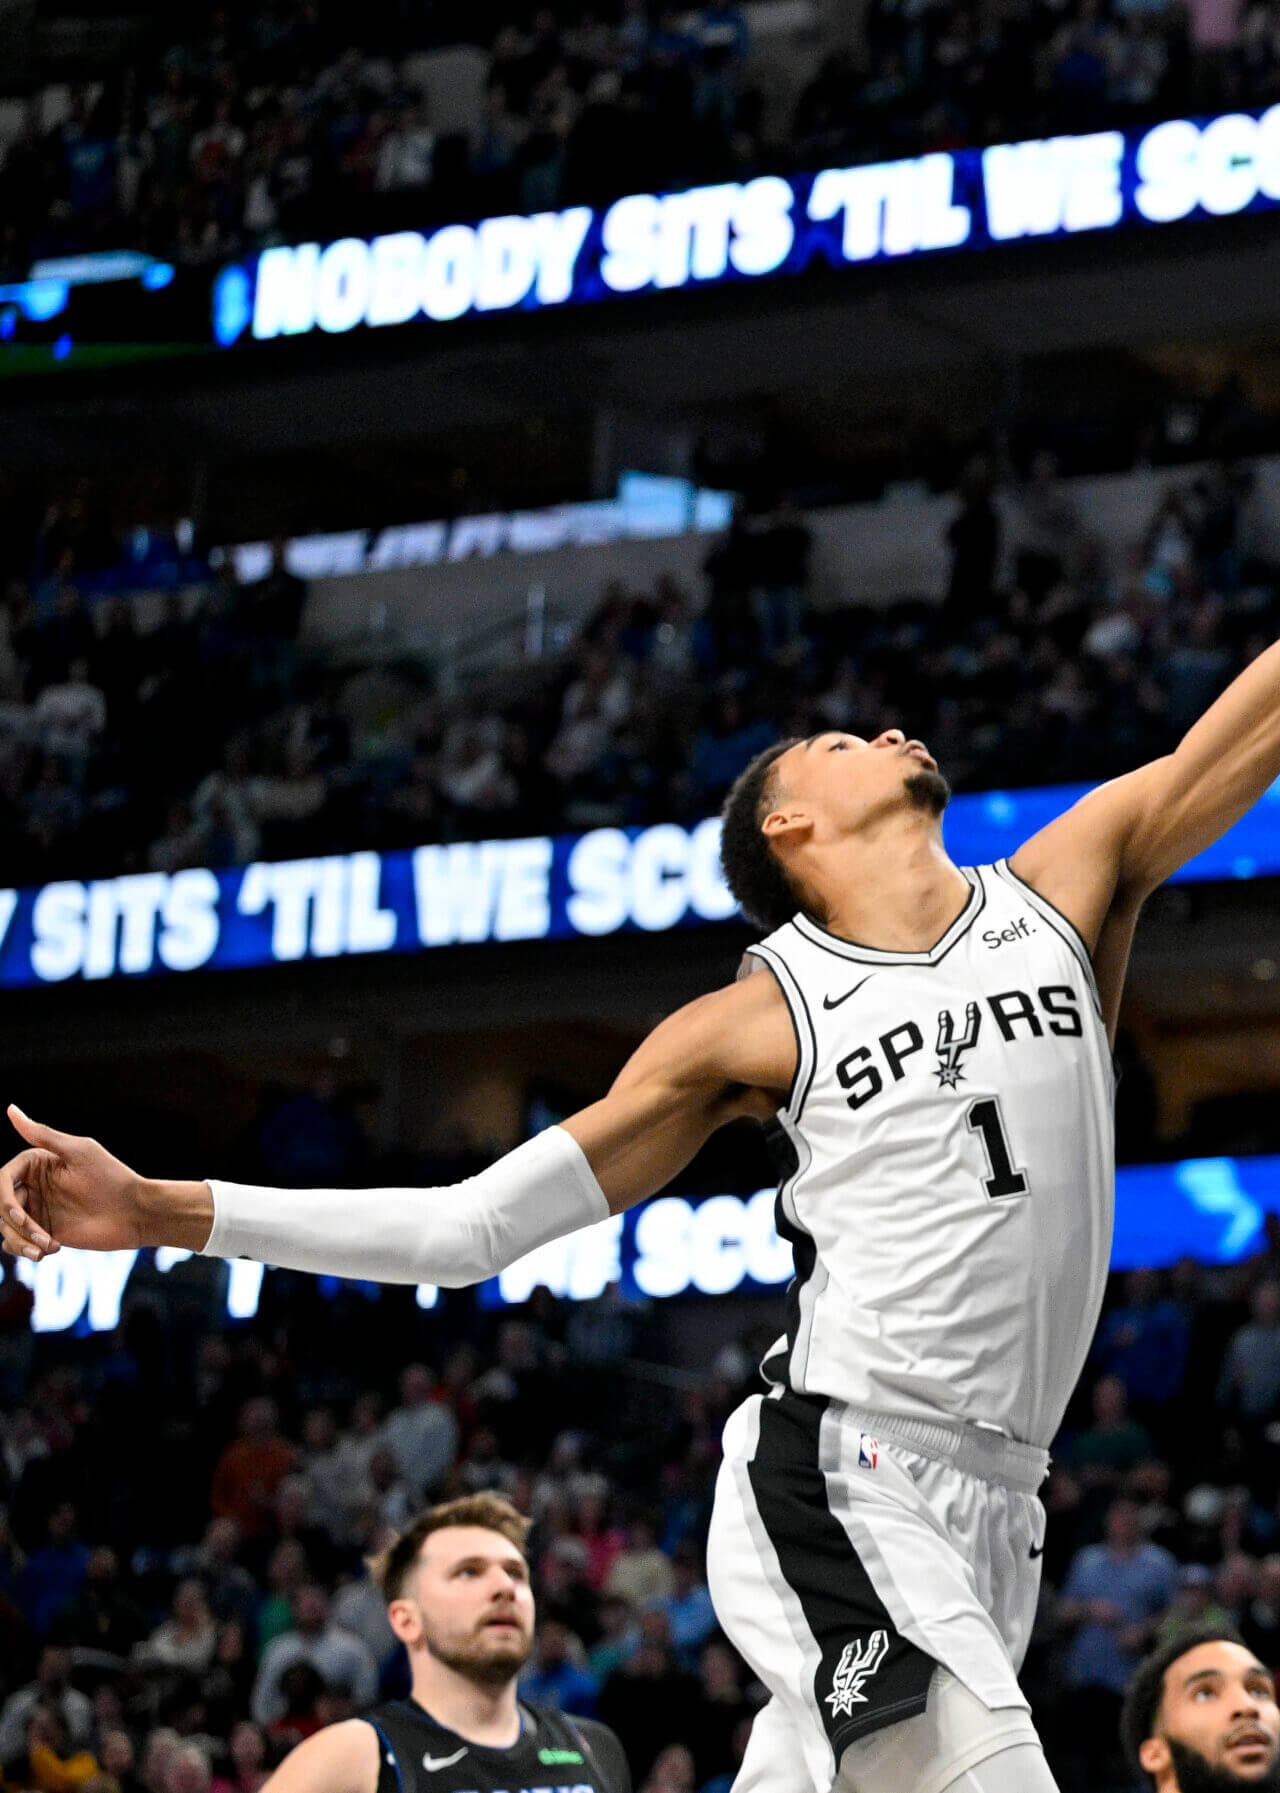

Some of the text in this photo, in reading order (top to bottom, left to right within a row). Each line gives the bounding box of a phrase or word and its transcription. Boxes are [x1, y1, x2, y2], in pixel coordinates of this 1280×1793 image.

[253, 207, 592, 339] NOBODY
[600, 176, 794, 291] SITS
[982, 131, 1124, 240] WE
[30, 868, 219, 981] SITS
[413, 836, 553, 947] WE
[982, 917, 1037, 949] Self.
[836, 985, 1083, 1111] SPURS
[965, 1094, 1031, 1204] 1
